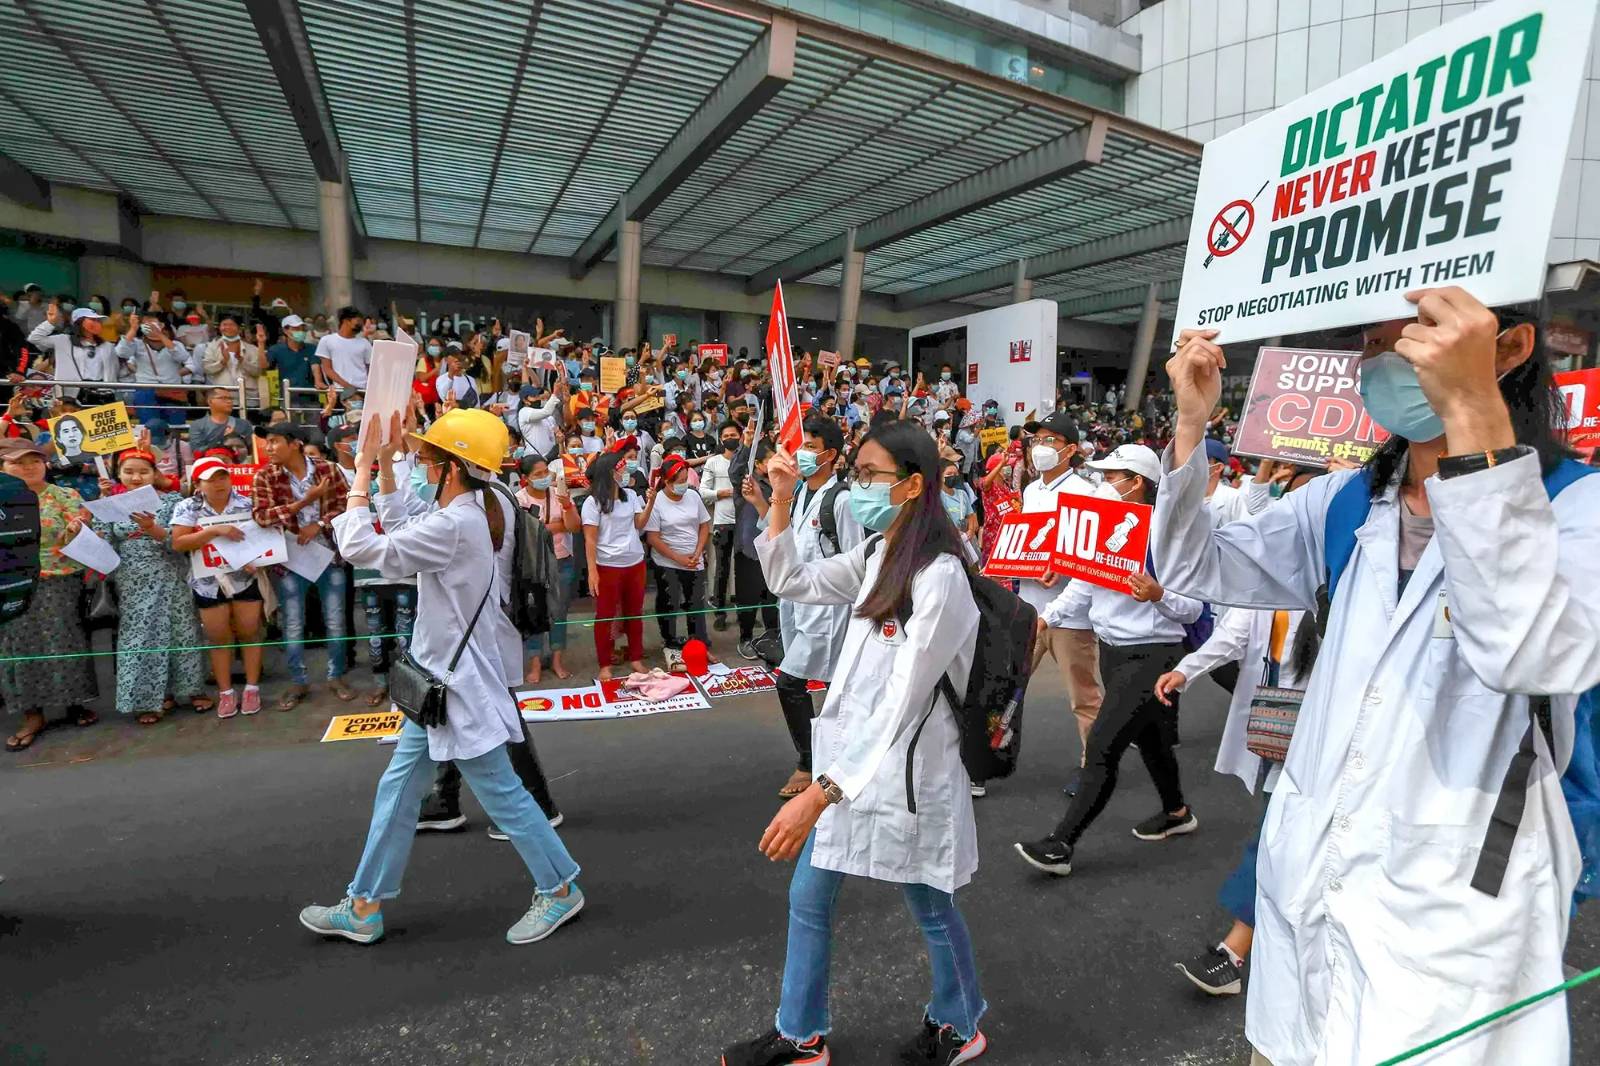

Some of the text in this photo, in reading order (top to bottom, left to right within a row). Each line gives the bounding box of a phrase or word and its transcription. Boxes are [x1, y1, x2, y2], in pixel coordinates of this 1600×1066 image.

[1279, 12, 1544, 178] DICTATOR
[1271, 95, 1525, 222] NEVER KEEPS
[1260, 158, 1512, 285] PROMISE
[1197, 250, 1495, 326] STOP NEGOTIATING WITH THEM
[1281, 354, 1349, 376] JOIN
[90, 408, 117, 421] FREE
[95, 417, 117, 428] OUR
[88, 421, 128, 437] LEADER
[991, 522, 1030, 560] NO
[1055, 505, 1100, 561] NO
[1075, 564, 1087, 573] OUR
[1086, 567, 1122, 583] GOVERNMENT
[1094, 551, 1141, 574] RE-ELECTION
[722, 676, 750, 690] CDM
[561, 693, 601, 711] NO
[344, 721, 397, 733] CDM
